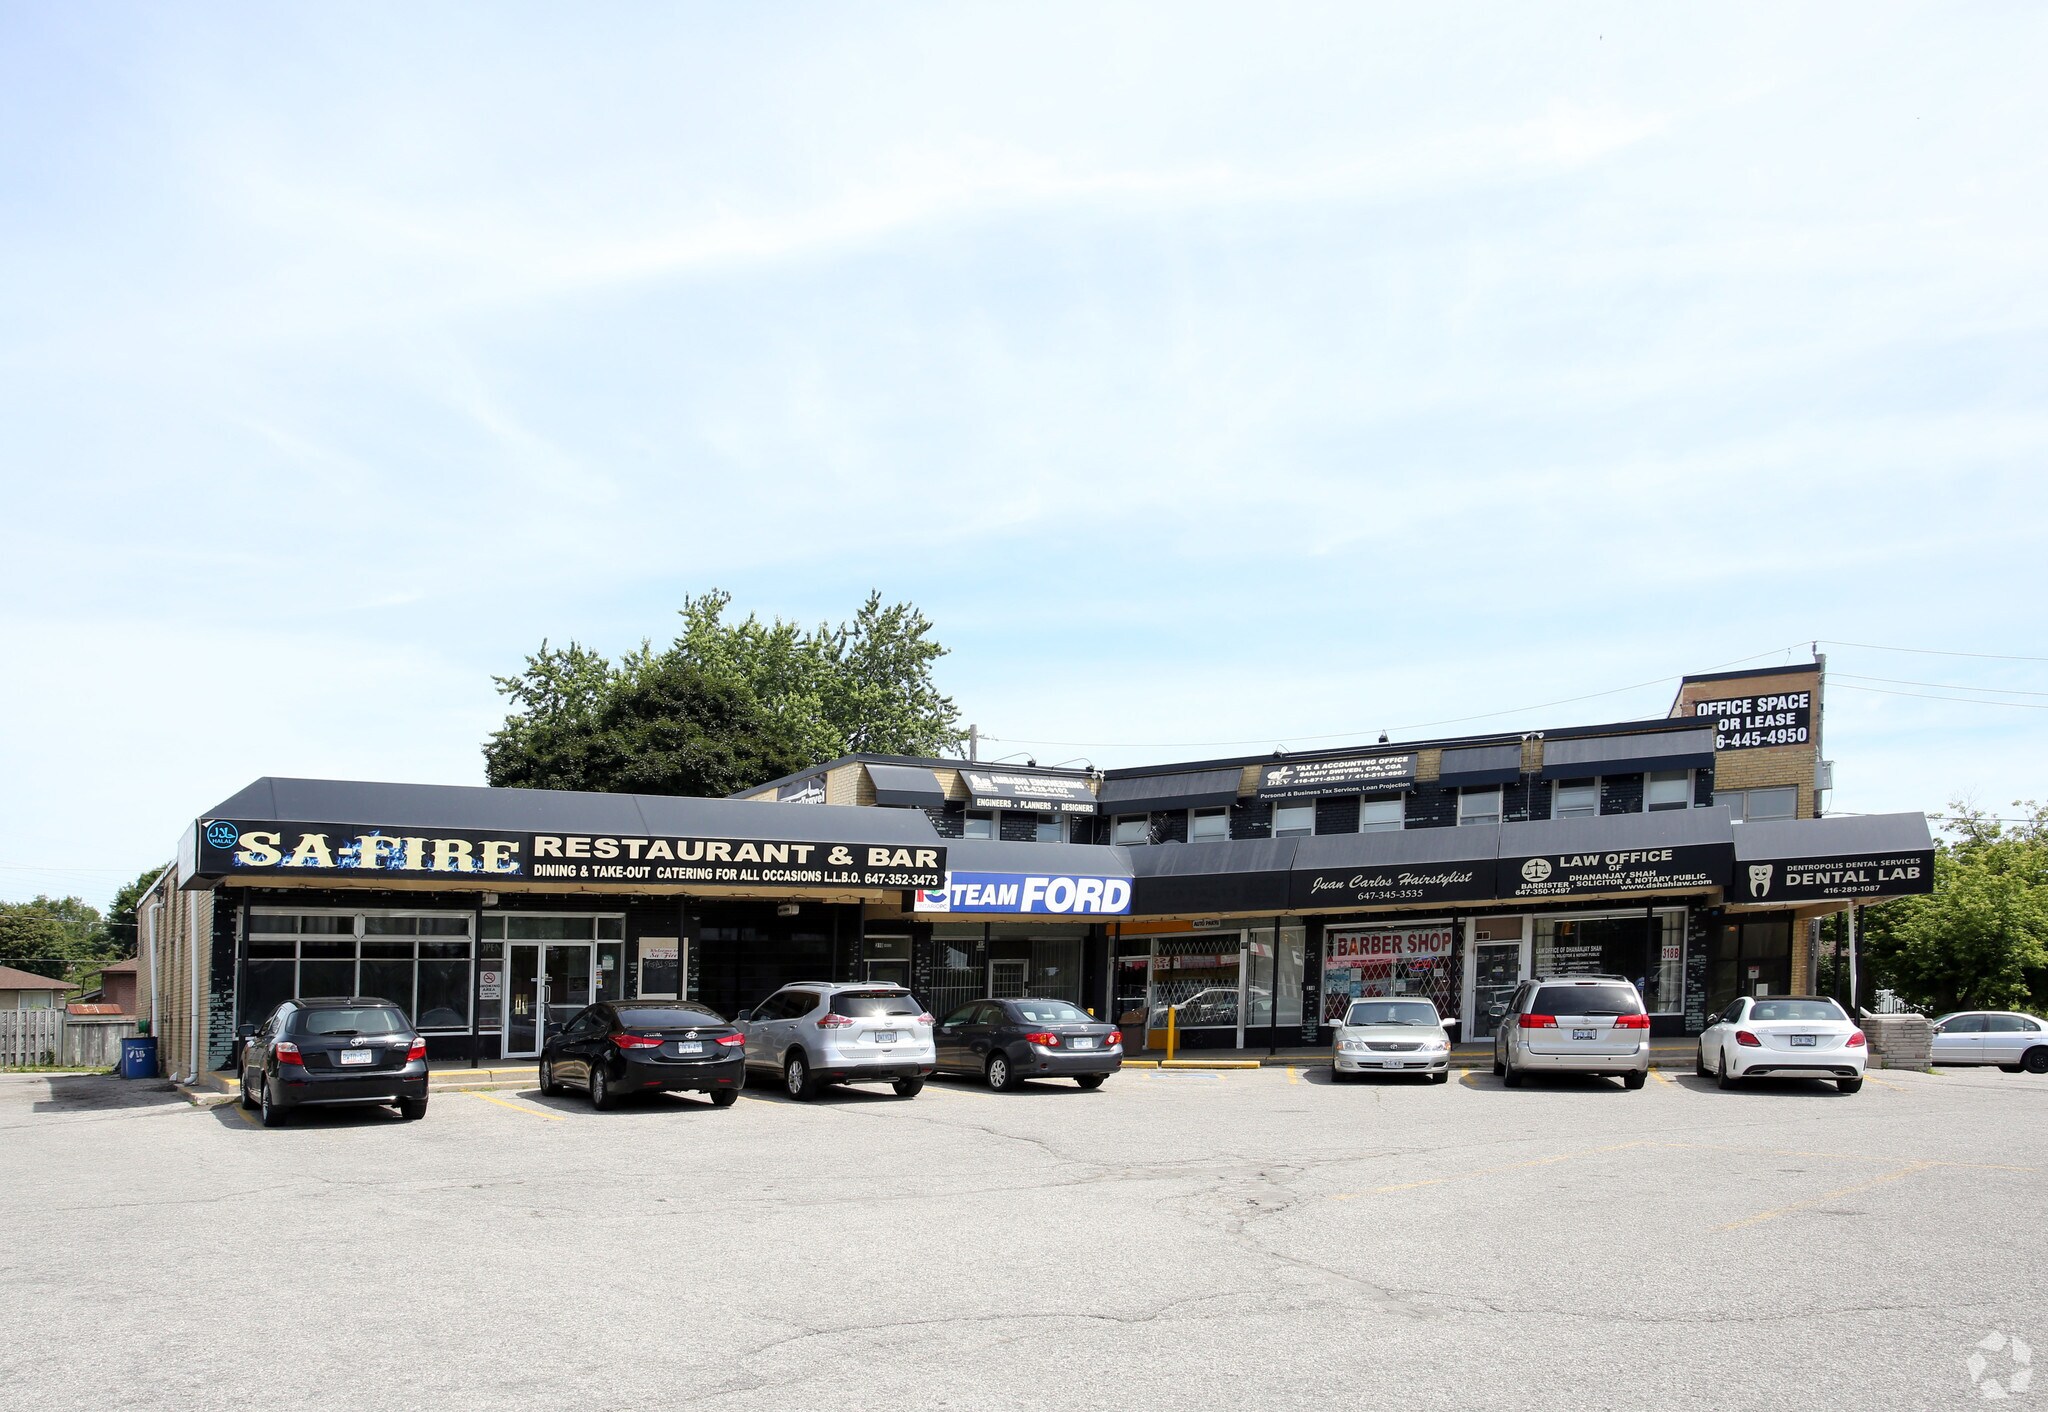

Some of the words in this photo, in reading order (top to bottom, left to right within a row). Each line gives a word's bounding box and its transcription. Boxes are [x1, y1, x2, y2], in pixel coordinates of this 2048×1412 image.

[1697, 699, 1752, 716] OFFICE
[1757, 694, 1809, 712] SPACE
[1718, 718, 1741, 731] OR
[1745, 712, 1796, 729] LEASE
[1716, 727, 1807, 749] 6-445-4950
[1321, 760, 1376, 769] ACCOUNTING
[1378, 756, 1409, 764] OFFICE
[1267, 778, 1291, 786] DEV
[1293, 789, 1320, 797] Business
[1379, 782, 1410, 790] Projection
[976, 798, 1012, 808] ENGINEERS
[1020, 800, 1051, 810] PLANNERS
[1061, 802, 1094, 813] DESIGNERS
[235, 832, 520, 874] SA-FIRE
[534, 836, 815, 864] RESTAURANT
[827, 846, 854, 865] &
[867, 847, 938, 868] BAR
[1559, 855, 1600, 868] LAW
[1605, 850, 1673, 865] OFFICE
[1787, 863, 1844, 872] DENTROPOLIS
[1880, 858, 1921, 866] SERVICES
[534, 863, 577, 877] DINING
[580, 864, 589, 878] &
[592, 865, 651, 879] TAKE-OUT
[656, 866, 713, 880] CATERING
[716, 868, 737, 881] FOR
[739, 869, 759, 881] ALL
[762, 869, 822, 882] OCCASIONS
[824, 871, 861, 884] L.L.B.O.
[864, 872, 938, 886] 647-352-3473
[1310, 876, 1345, 894] Juan
[1348, 874, 1394, 889] Carlos
[1397, 871, 1473, 888] Hairstylist
[1569, 872, 1626, 881] DHANANJAY
[1629, 870, 1656, 878] SHAH
[1576, 879, 1623, 888] SOLICITOR
[1635, 876, 1670, 884] NOTARY
[1673, 873, 1706, 881] PUBLIC
[1786, 870, 1870, 886] DENTAL
[1878, 867, 1921, 882] LAB
[1620, 879, 1712, 891] www.dshahlaw.com
[1823, 885, 1881, 894] 416-289-1087
[951, 883, 1019, 906] TEAM
[1020, 877, 1131, 913] FORD
[1357, 889, 1423, 900] 647-345-3535
[1337, 935, 1403, 957] BARBER
[1407, 932, 1452, 953] SHOP
[1662, 948, 1680, 959] 318B
